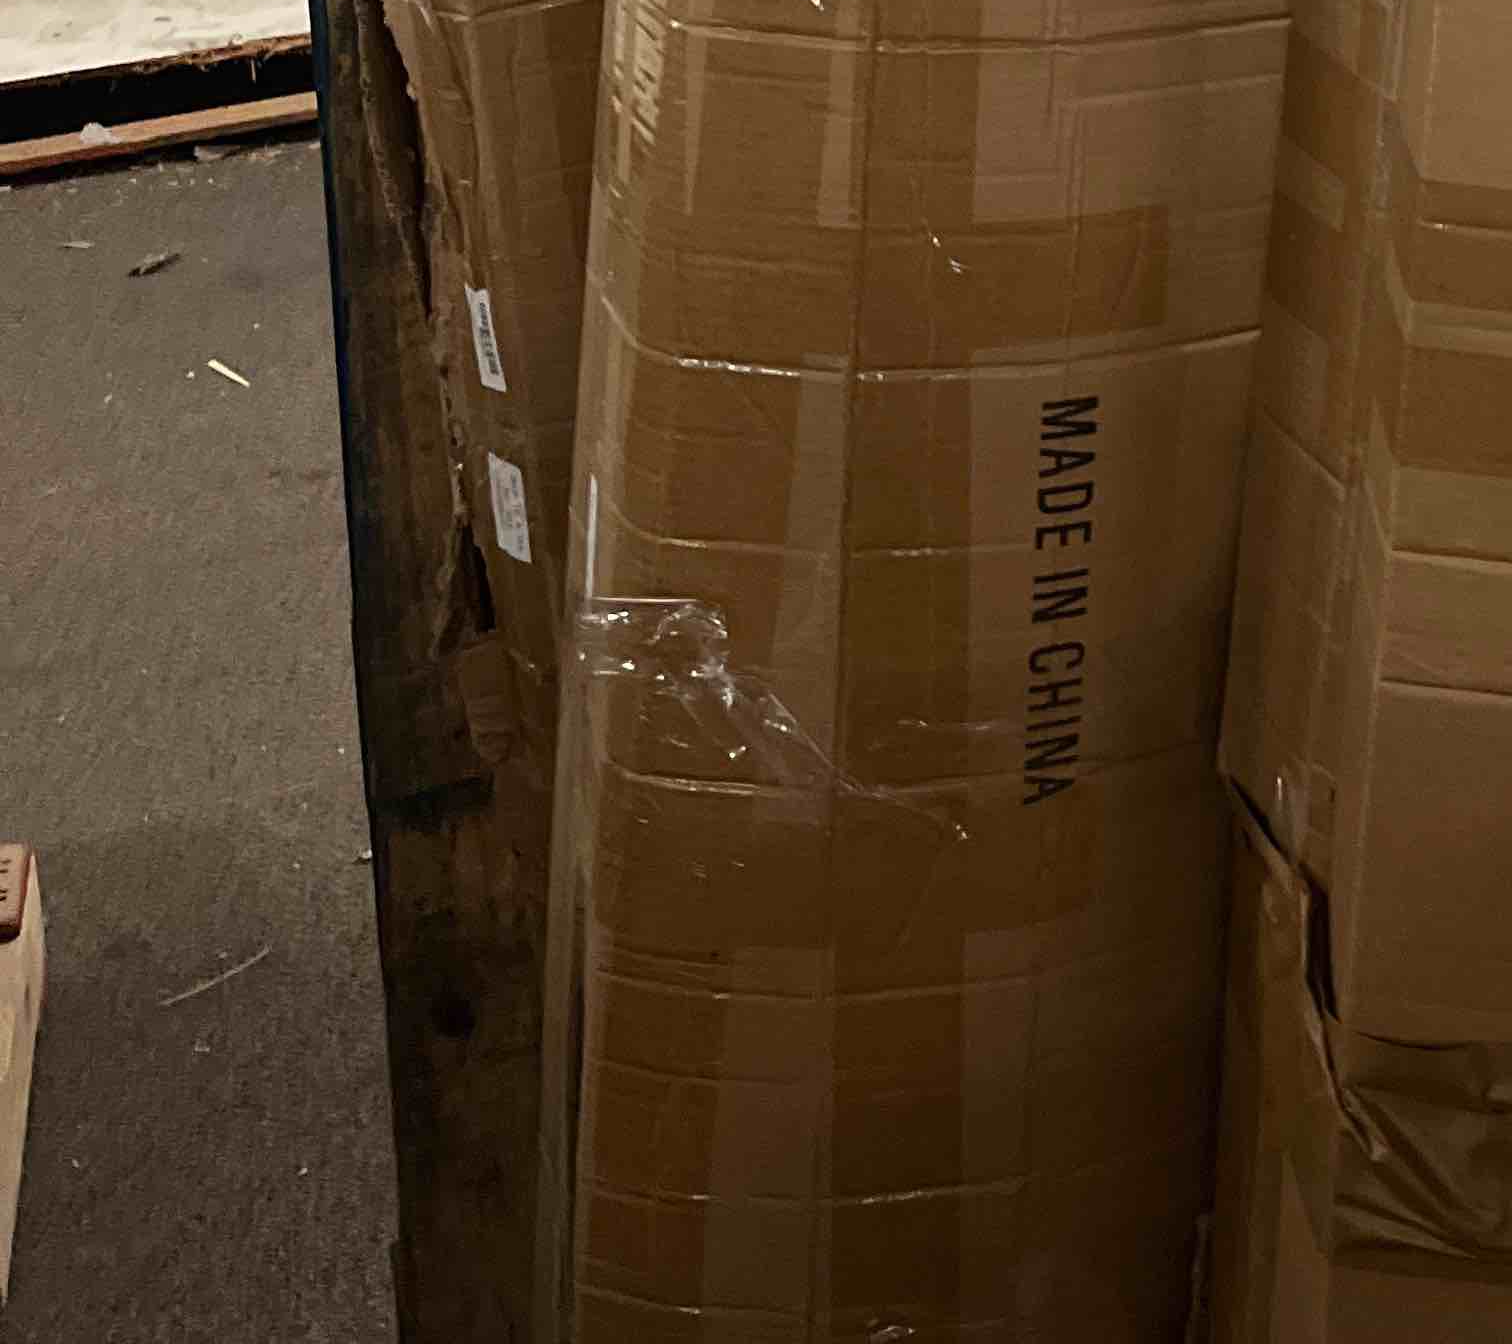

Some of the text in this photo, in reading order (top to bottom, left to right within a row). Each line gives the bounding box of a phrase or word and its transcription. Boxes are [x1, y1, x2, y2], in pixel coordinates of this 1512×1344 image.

[1023, 396, 1099, 806] MADE IN CHINA
